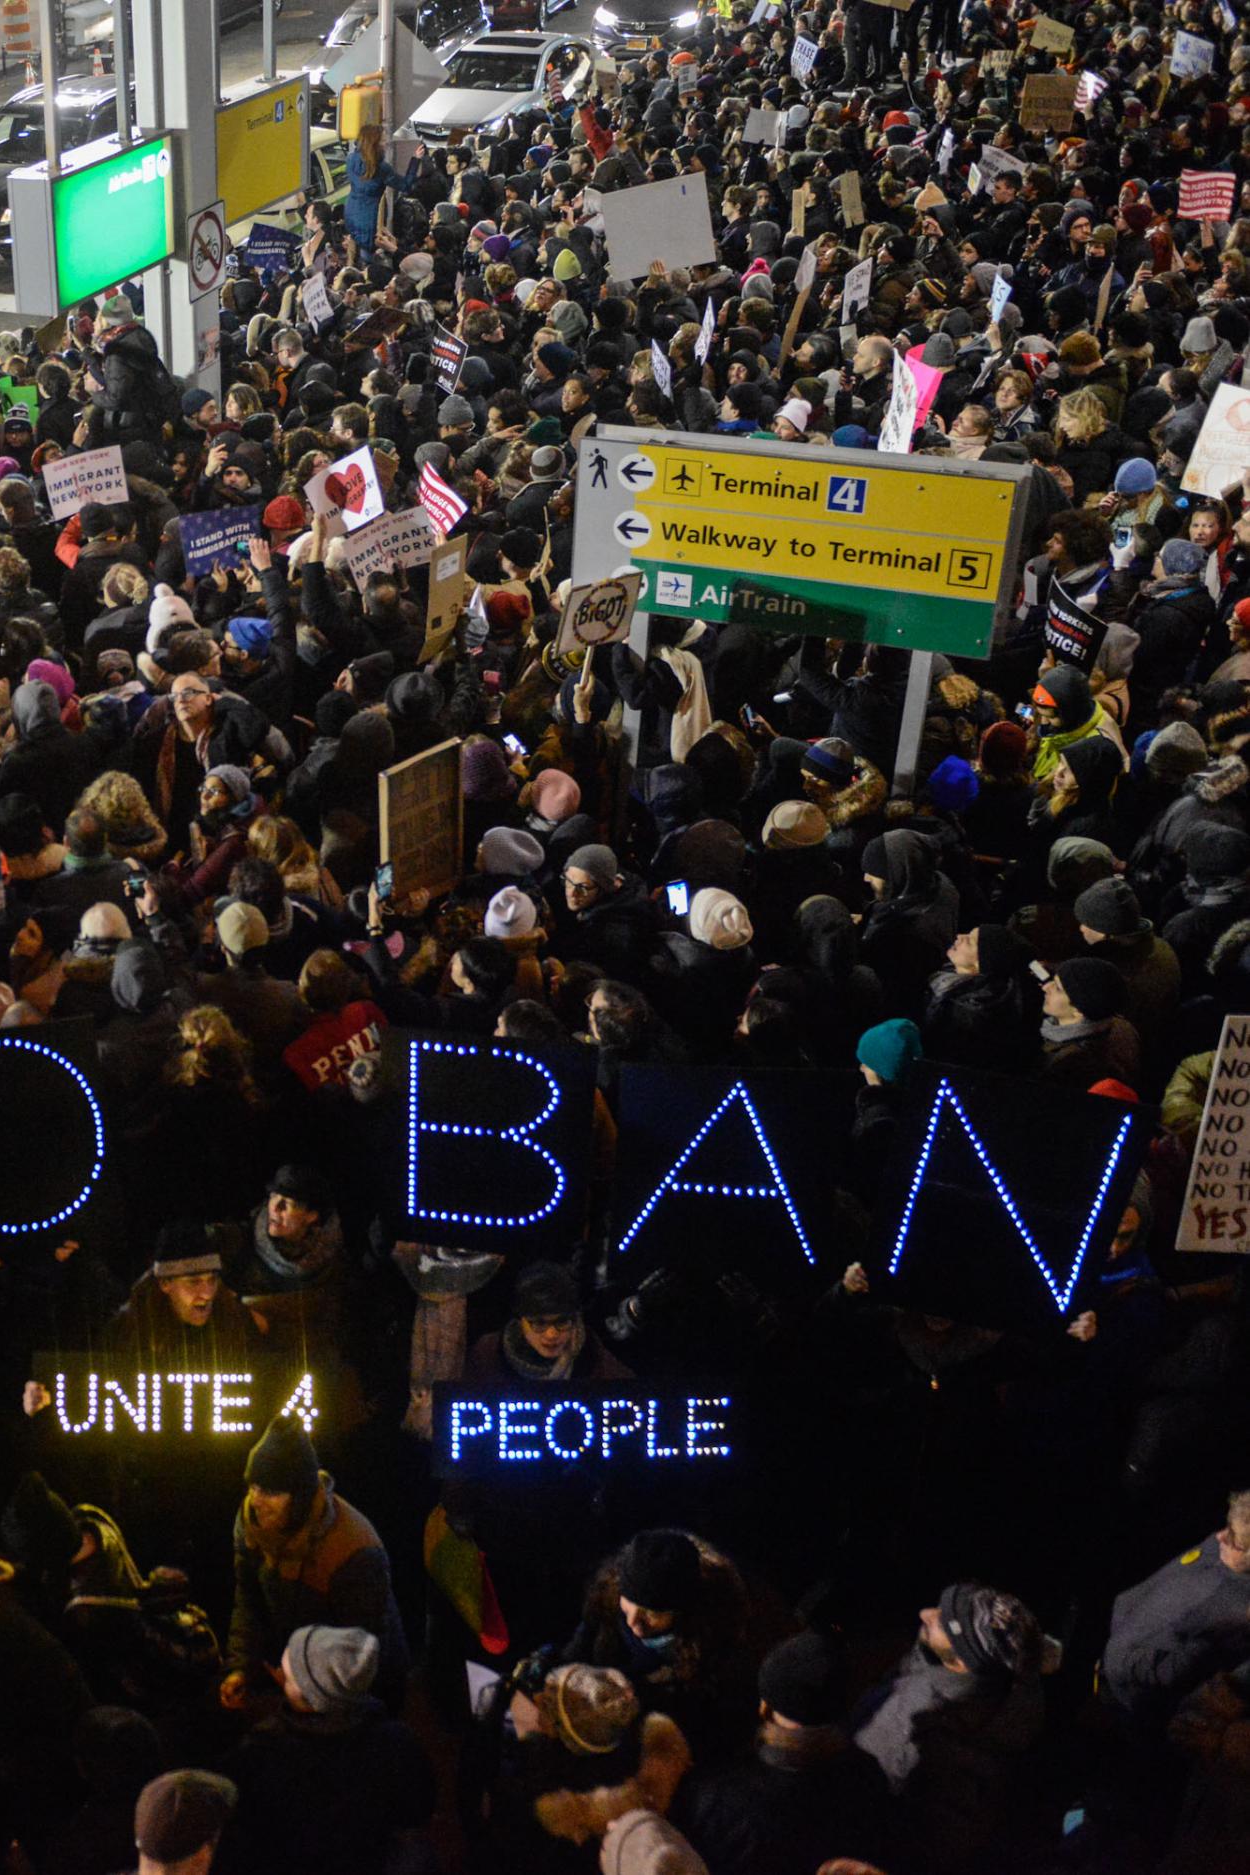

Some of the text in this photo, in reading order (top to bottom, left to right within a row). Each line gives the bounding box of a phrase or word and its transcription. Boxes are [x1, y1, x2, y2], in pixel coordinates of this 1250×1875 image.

[247, 110, 273, 131] Terminal
[52, 490, 77, 506] NEW
[711, 472, 861, 512] Terminal 4
[196, 531, 223, 547] STAND
[225, 523, 250, 536] WITH
[370, 521, 390, 537] NEW
[392, 512, 415, 528] YORK
[661, 521, 979, 582] Walkway to Terminal 5
[355, 556, 383, 580] NEW
[700, 584, 807, 617] AirTrain
[1211, 1088, 1250, 1107] NO
[1207, 1115, 1244, 1134] NO
[1201, 1138, 1238, 1157] NO
[1197, 1161, 1229, 1178] NO
[1192, 1183, 1225, 1199] NO
[1193, 1203, 1248, 1241] YES
[54, 1372, 320, 1433] UNITE 4
[450, 1397, 732, 1461] PEOPLE
